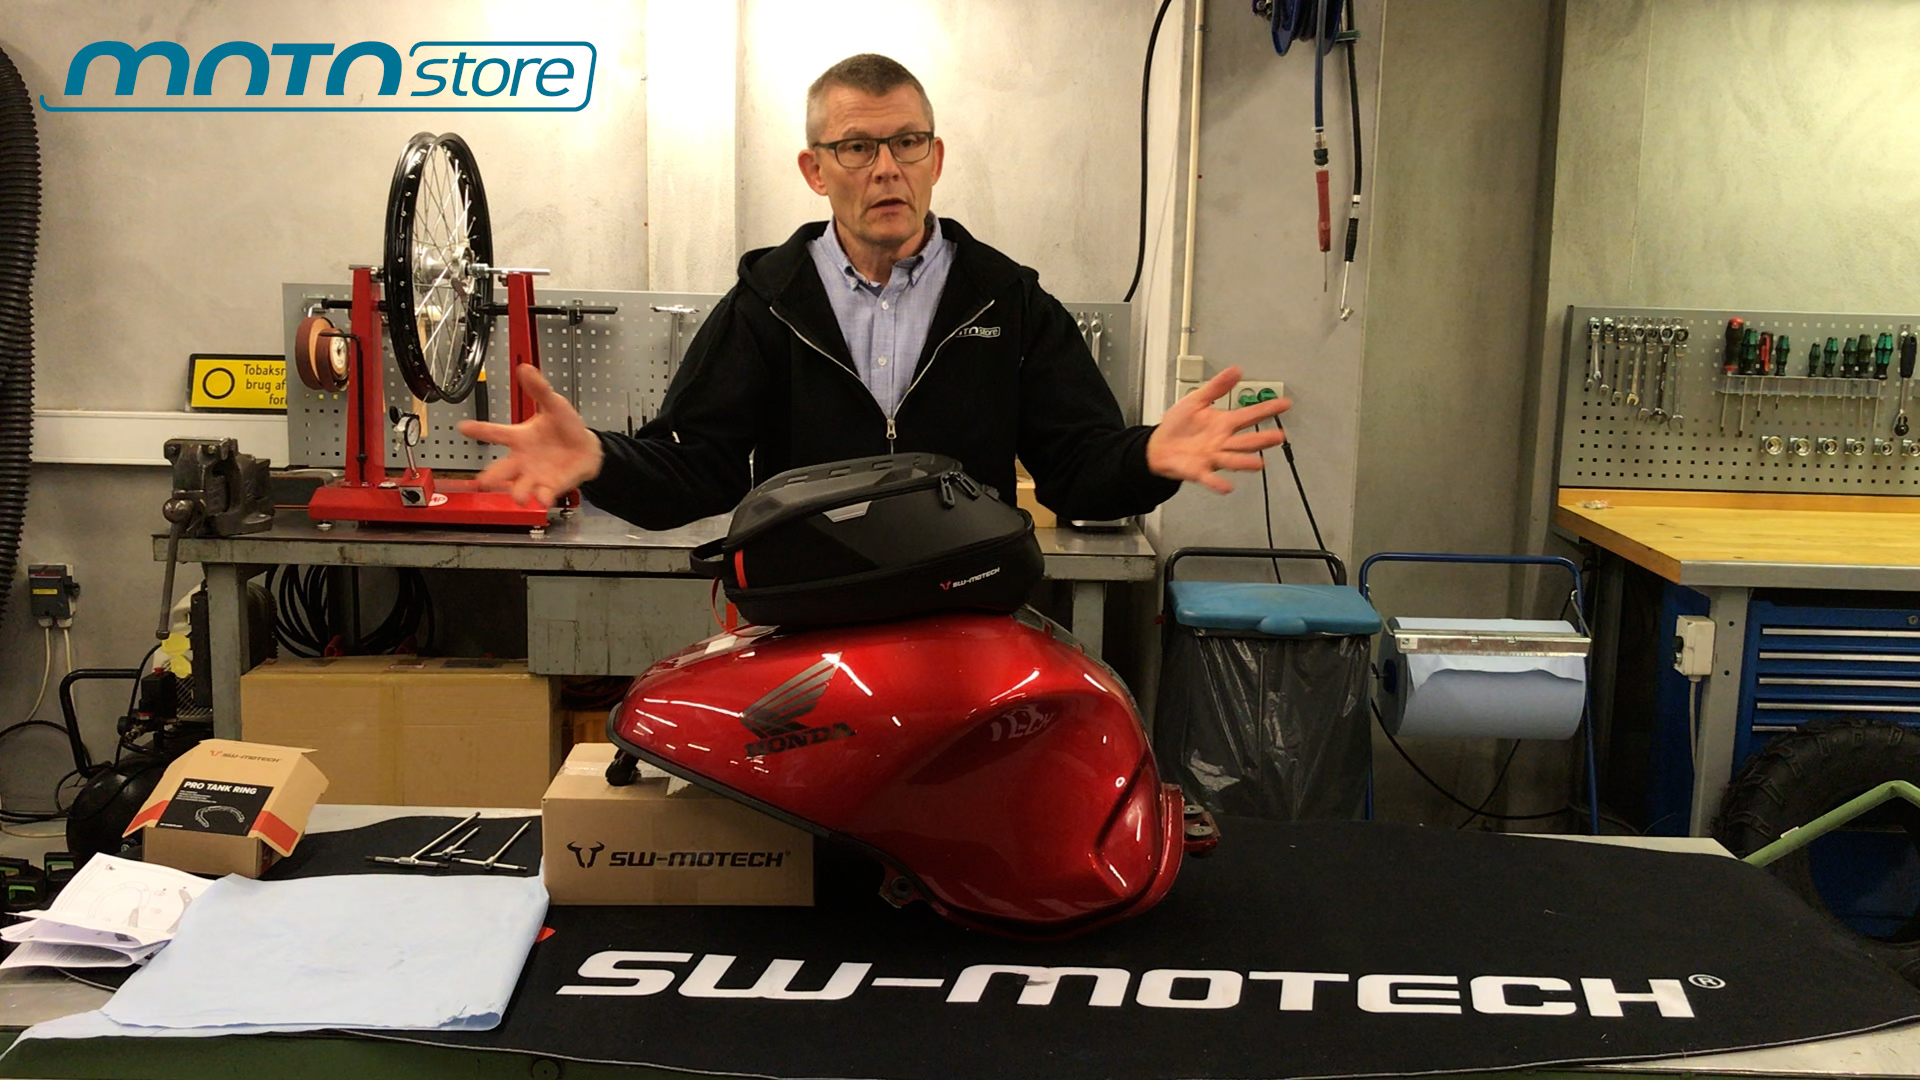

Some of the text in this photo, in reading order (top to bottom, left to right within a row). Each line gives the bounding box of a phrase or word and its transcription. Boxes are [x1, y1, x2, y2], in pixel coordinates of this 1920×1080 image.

[245, 379, 271, 393] brug
[268, 394, 287, 405] for
[952, 566, 1000, 588] SW-MOTECH
[744, 722, 857, 758] HONDA
[221, 752, 281, 763] SW-MOTECH
[183, 780, 258, 795] PRO TANK RING
[608, 851, 784, 868] SW-MOTECH
